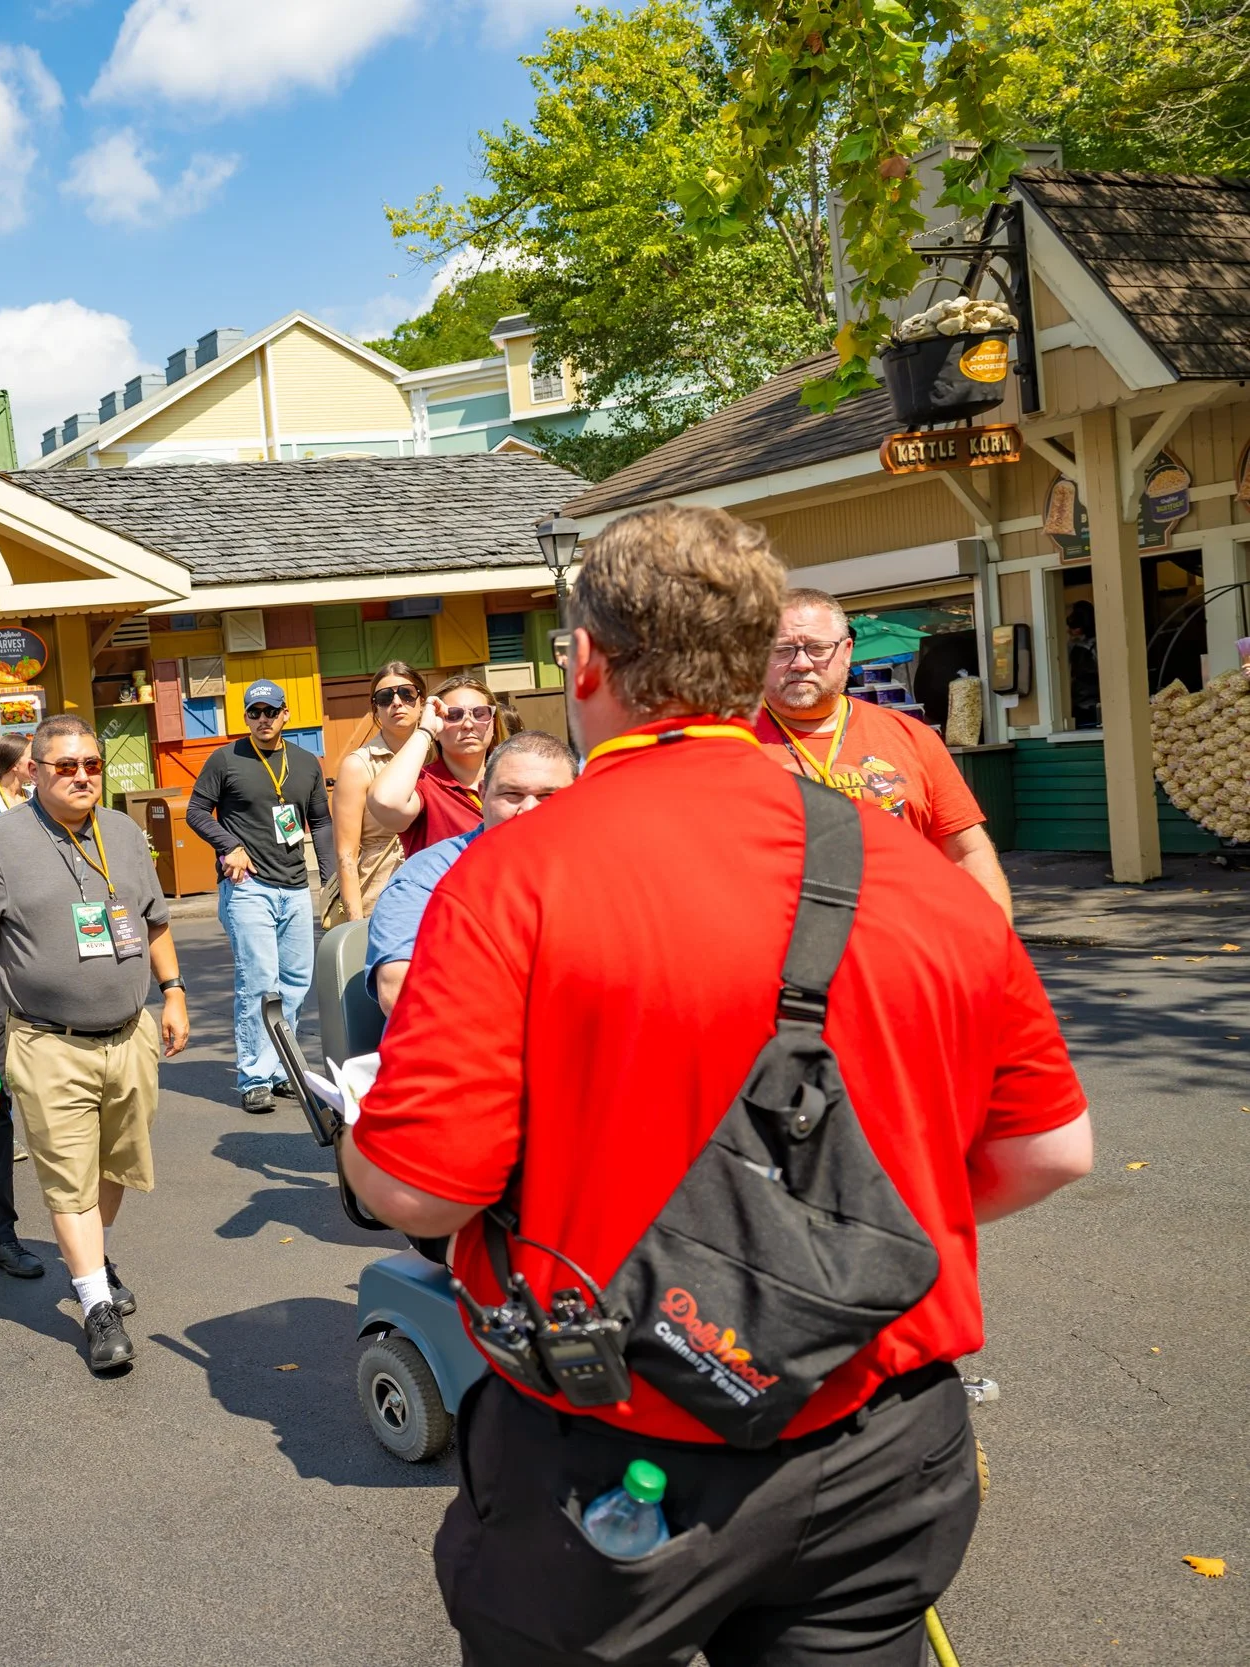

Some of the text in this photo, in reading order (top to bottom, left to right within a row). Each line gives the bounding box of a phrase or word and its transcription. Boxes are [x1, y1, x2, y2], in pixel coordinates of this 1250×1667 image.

[896, 433, 1012, 464] KETTLE KORN
[107, 762, 145, 777] COOKING
[120, 779, 136, 792] OIL
[654, 1321, 751, 1407] Culinary Team
